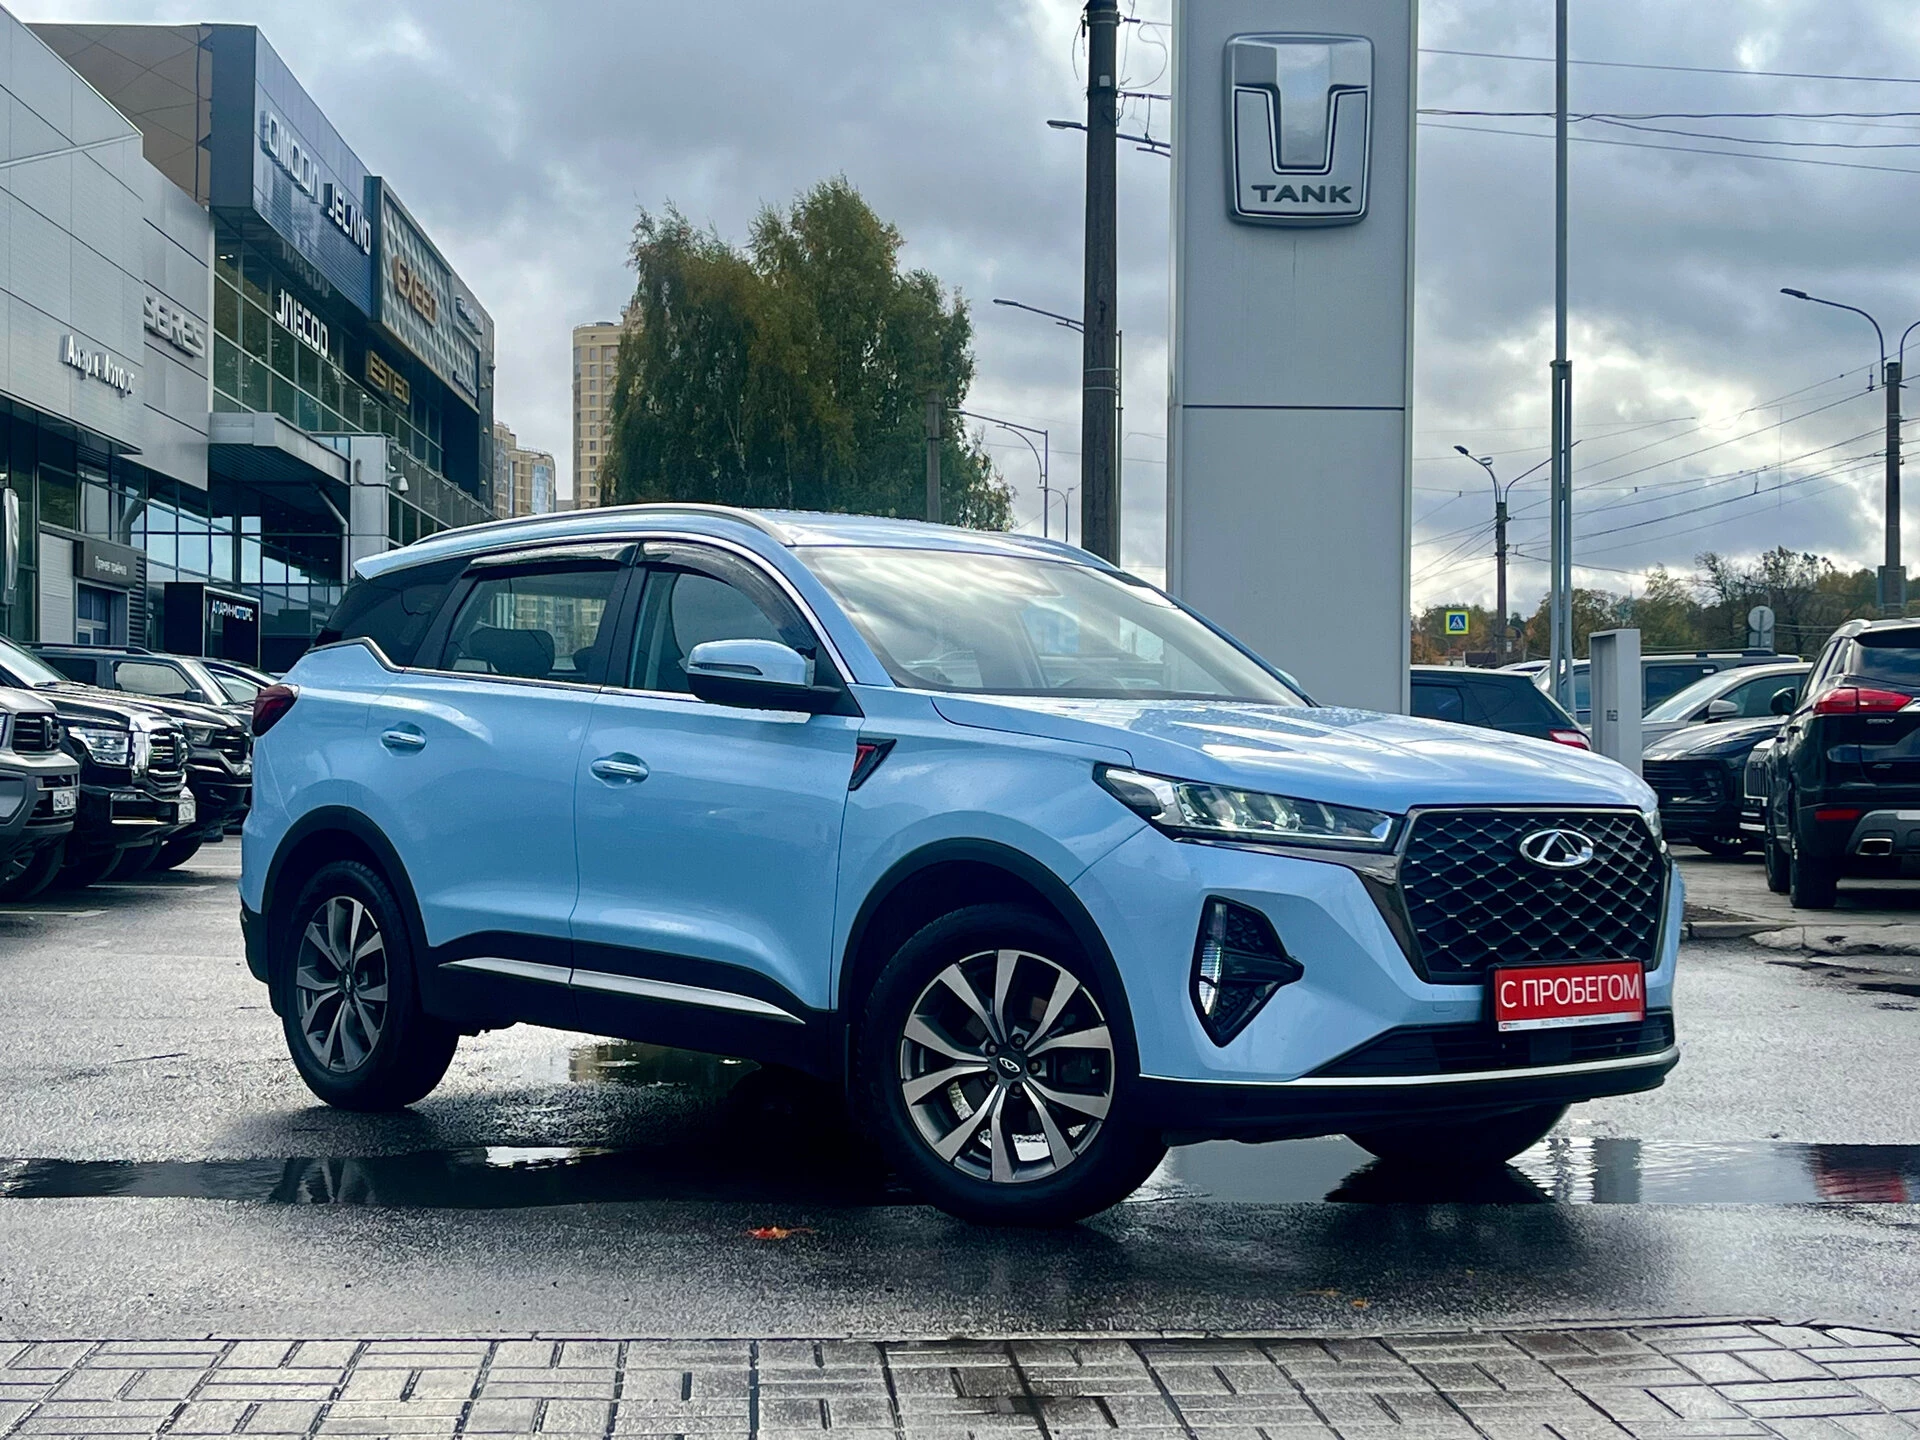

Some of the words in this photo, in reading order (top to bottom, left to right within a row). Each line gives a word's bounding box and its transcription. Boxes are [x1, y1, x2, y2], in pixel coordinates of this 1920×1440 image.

[268, 111, 320, 204] OMODA
[1251, 184, 1352, 203] TANK
[143, 293, 206, 359] SERES
[275, 288, 329, 358] JAECOO
[1500, 980, 1517, 1008] С
[1522, 973, 1640, 1006] ПРОБЕГОМ
